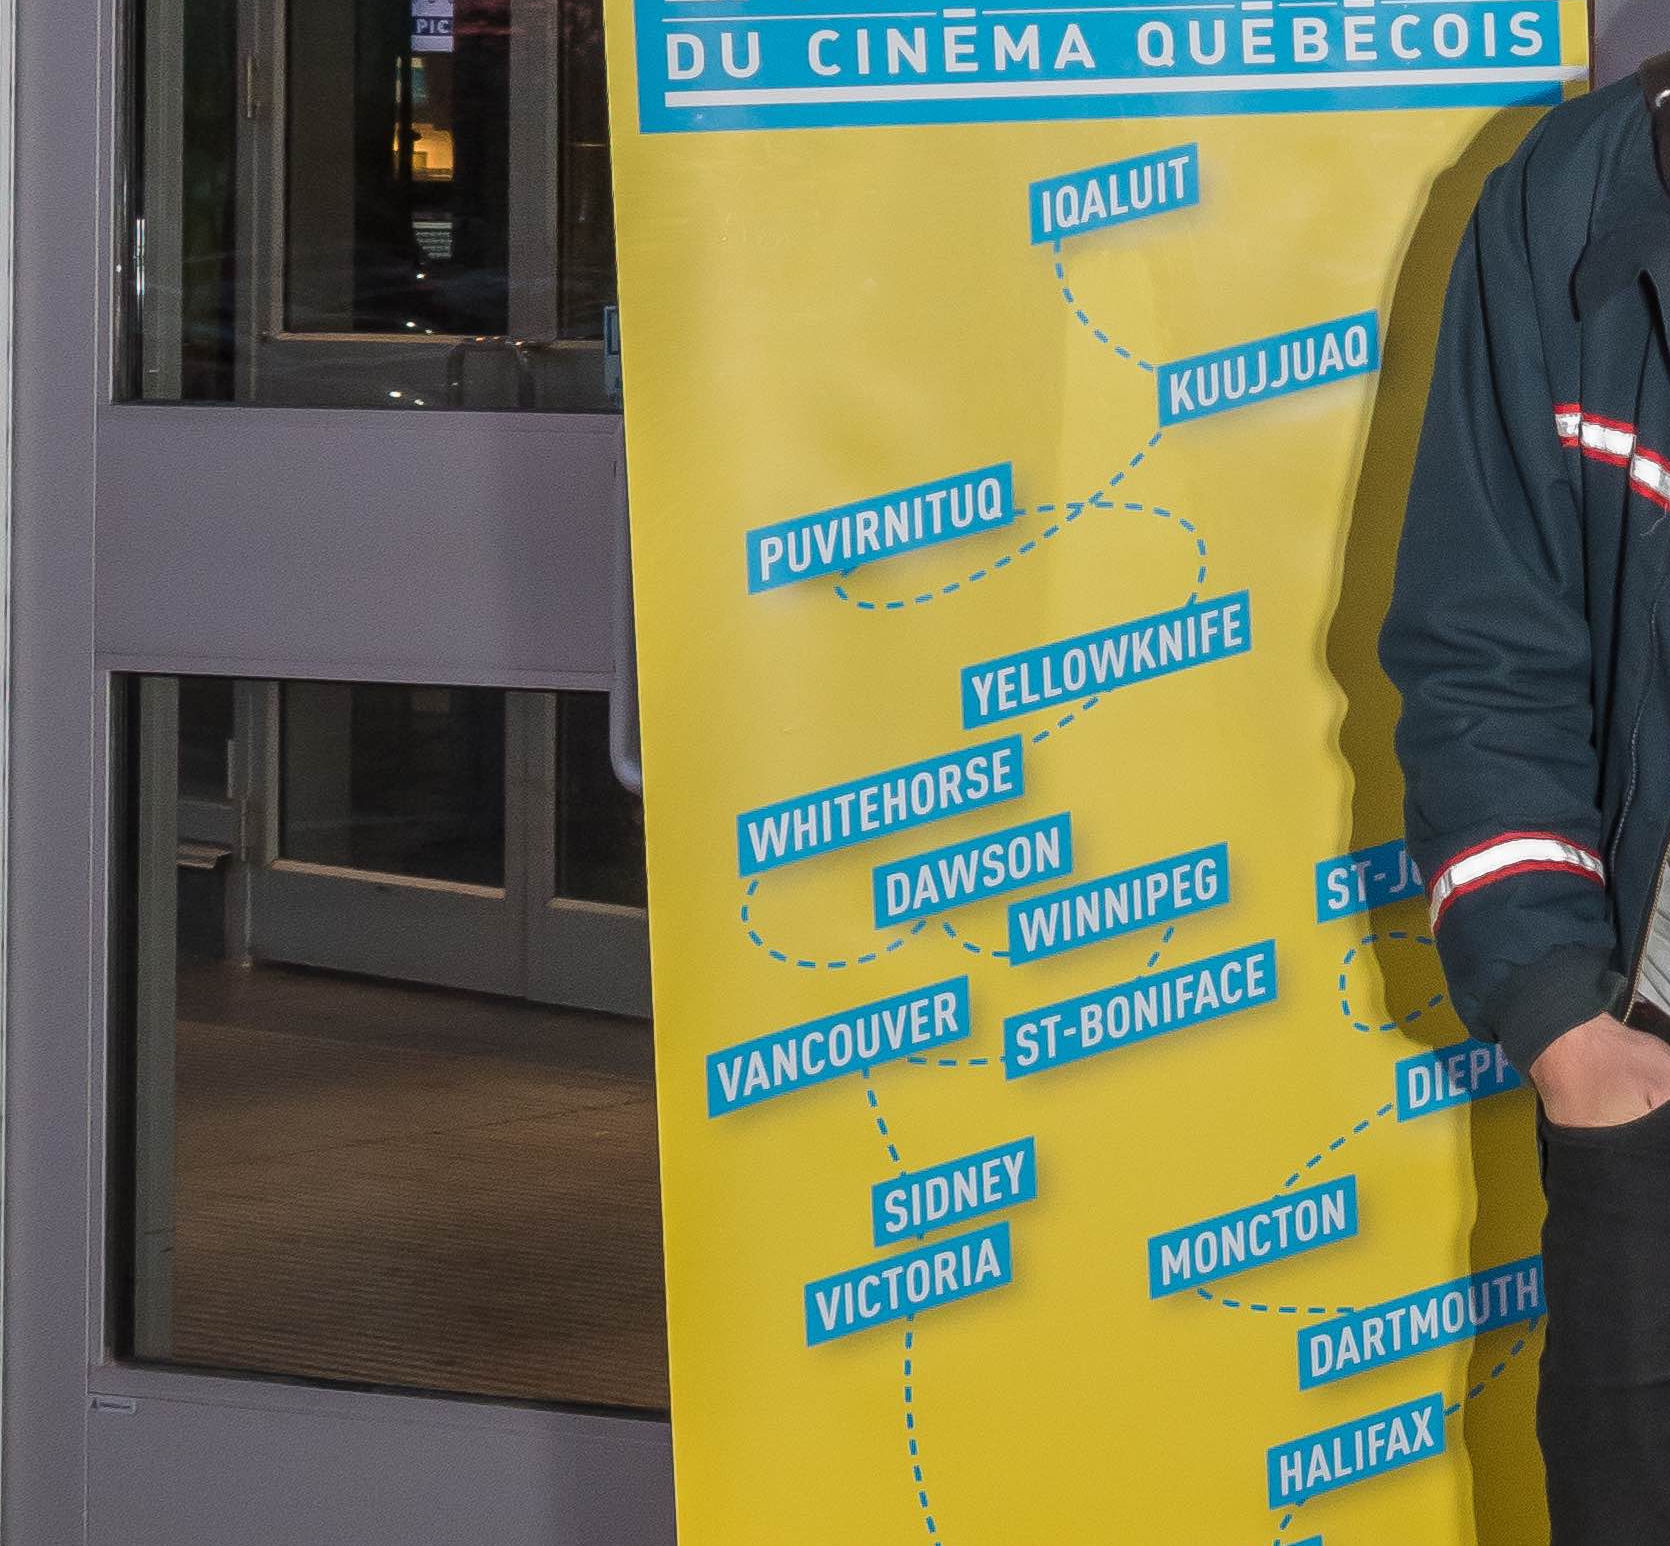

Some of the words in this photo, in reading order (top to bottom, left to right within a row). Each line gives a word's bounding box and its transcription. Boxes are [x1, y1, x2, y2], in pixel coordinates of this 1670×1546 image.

[667, 30, 763, 82] DU
[1042, 155, 1189, 233] IQALUIT
[1169, 325, 1370, 415] KUUJJUAQ
[759, 476, 1003, 582] PUVIRNITUQ
[971, 604, 1243, 717] YELLOWKNIFE
[747, 747, 1013, 863] WHITEHORSE
[885, 827, 1061, 916] DAWSON
[1020, 853, 1218, 953] WINNIPEG
[716, 991, 959, 1103] VANCOUVER
[1015, 953, 1267, 1067] ST-BONIFACE
[884, 1152, 1025, 1234] SIDNEY
[1161, 1191, 1345, 1287] MONCTON
[816, 1239, 1001, 1333] VICTORIA
[1310, 1270, 1540, 1378] DARTMOUTH
[1280, 1406, 1434, 1496] HALIFAX
